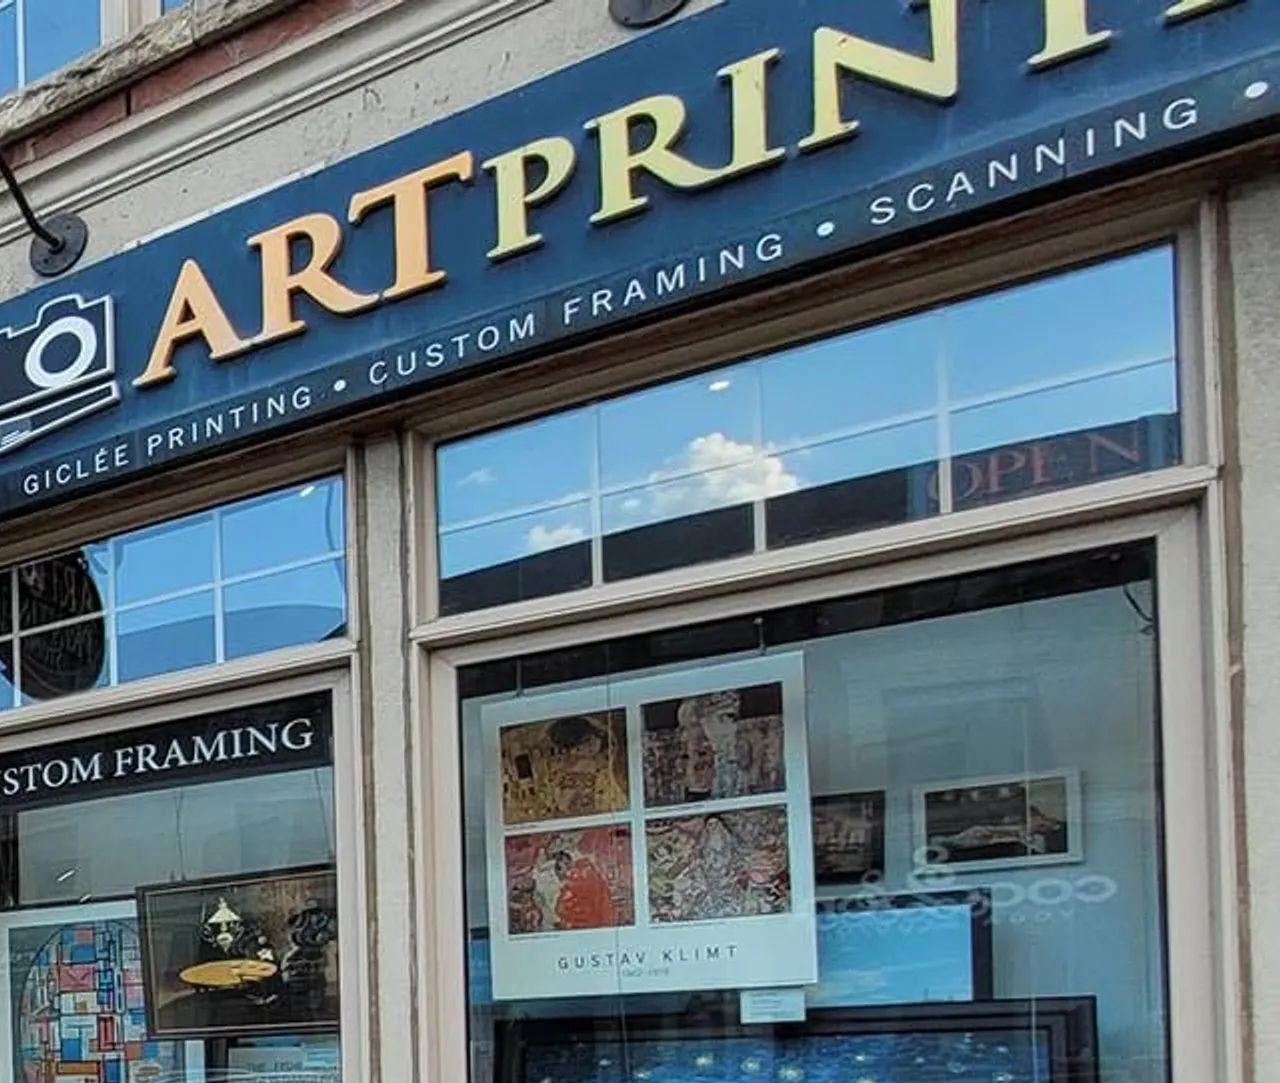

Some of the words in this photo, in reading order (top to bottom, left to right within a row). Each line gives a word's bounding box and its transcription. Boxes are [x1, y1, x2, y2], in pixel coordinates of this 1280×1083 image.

[23, 443, 130, 496] GICLÉE
[147, 385, 312, 457] PRINTING
[368, 313, 536, 386] CUSTOM
[563, 233, 784, 326] FRAMING
[869, 97, 1199, 226] SCANNING
[926, 422, 1142, 502] OPEN
[113, 717, 315, 779] FRAMING
[557, 952, 646, 970] GUSTAV
[662, 945, 738, 963] KLIMT
